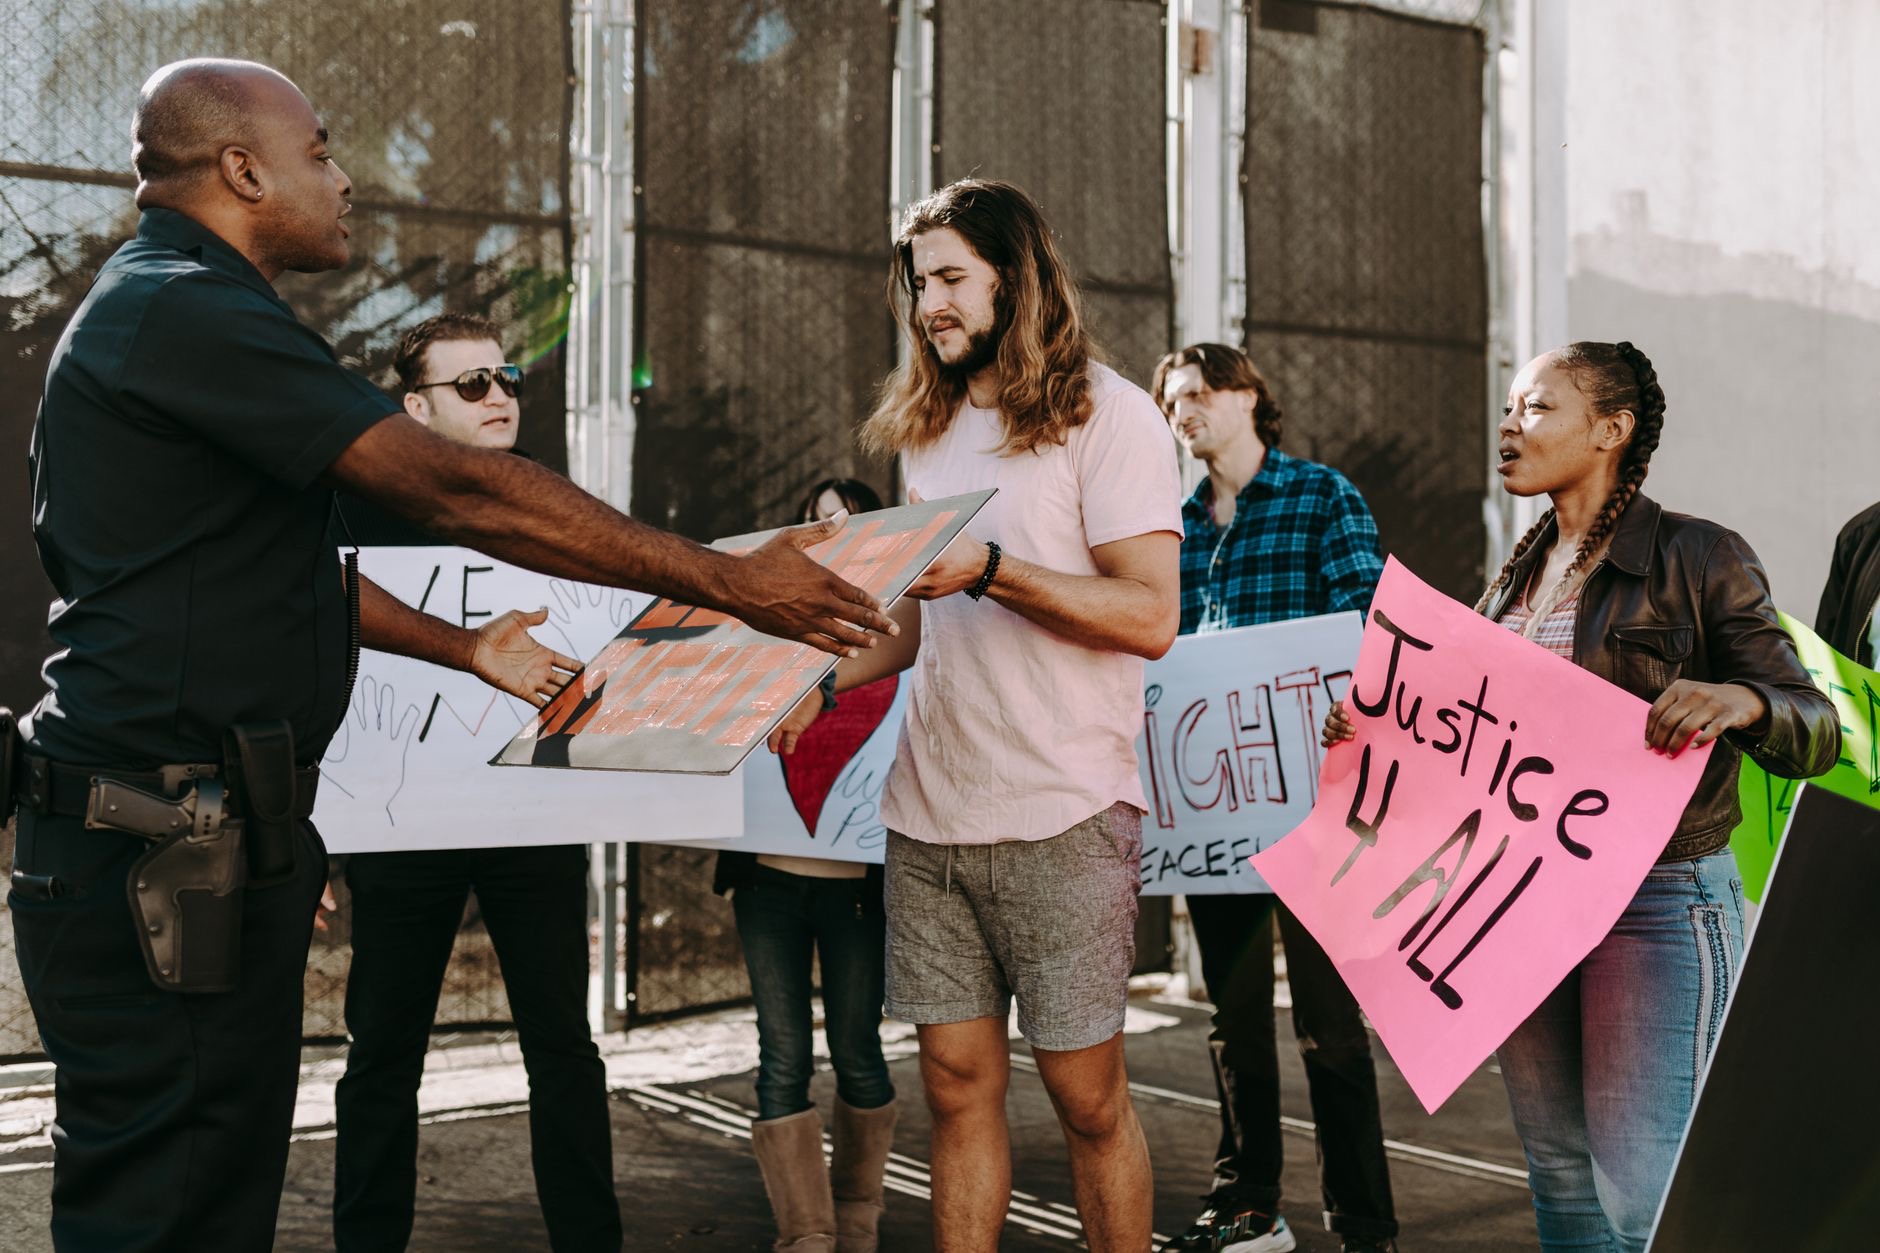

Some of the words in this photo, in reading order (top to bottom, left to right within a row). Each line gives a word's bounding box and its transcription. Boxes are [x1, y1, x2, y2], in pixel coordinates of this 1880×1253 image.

[1352, 609, 1609, 860] Justice
[830, 801, 887, 849] Pe
[1140, 837, 1263, 884] EACEF
[1330, 744, 1399, 887] 4
[1372, 809, 1543, 1010] ALL
